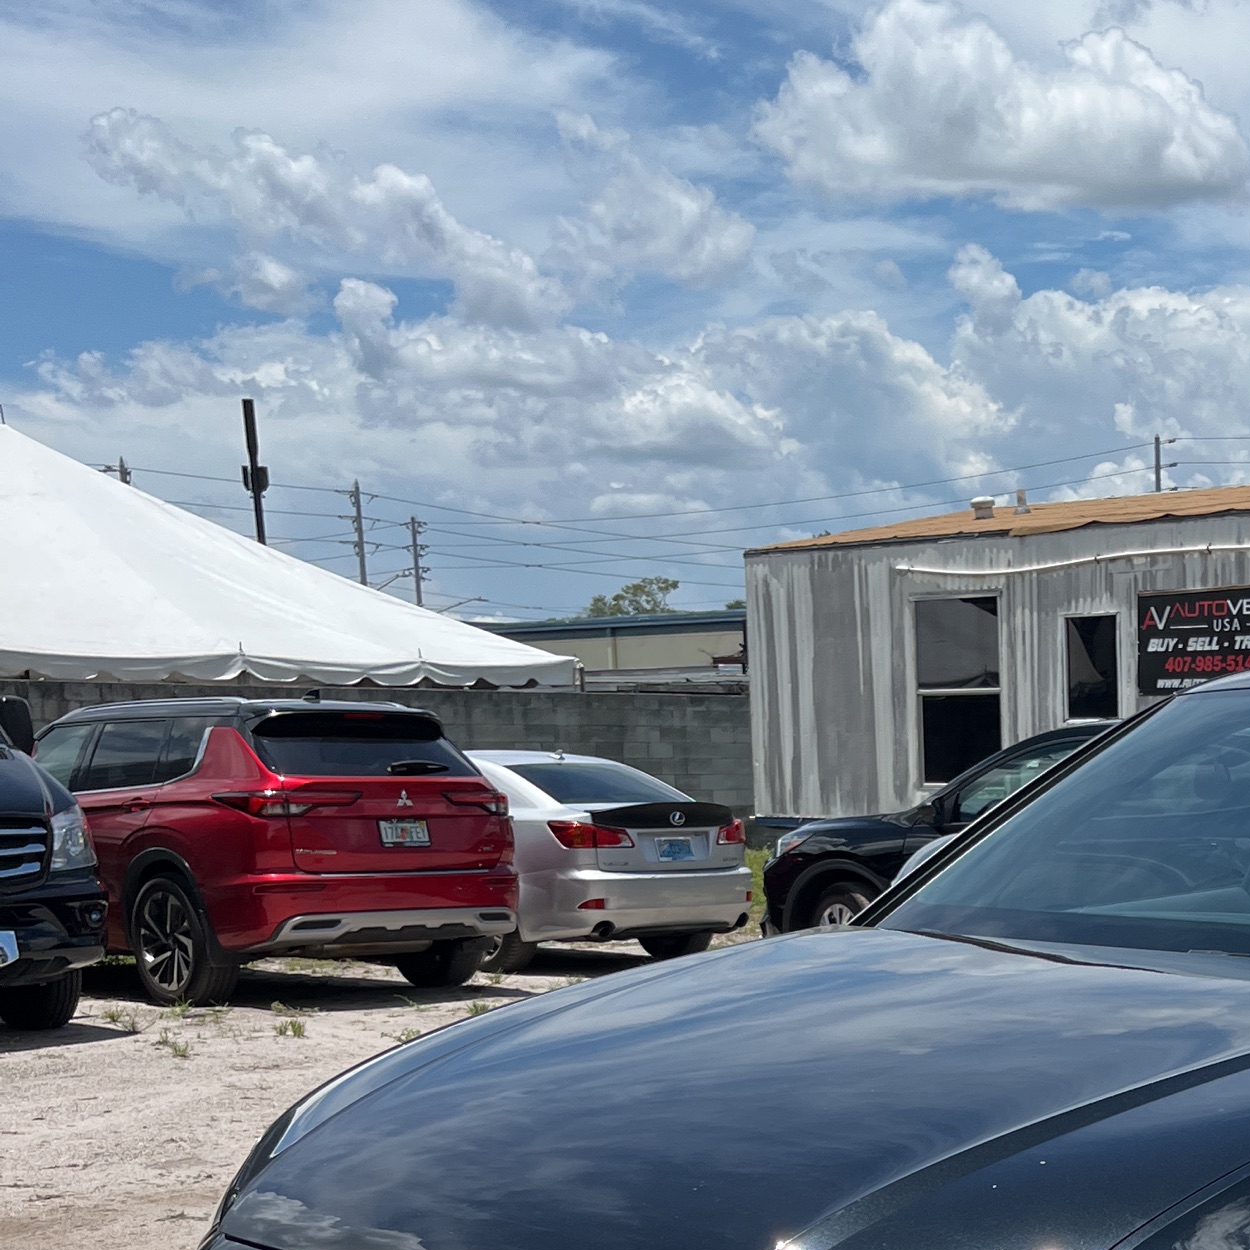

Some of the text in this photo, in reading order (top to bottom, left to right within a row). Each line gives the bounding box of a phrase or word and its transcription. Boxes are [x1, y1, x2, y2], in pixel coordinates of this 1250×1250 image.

[1142, 605, 1171, 631] AV
[1213, 618, 1241, 632] USA
[1147, 637, 1179, 652] BUY
[1186, 636, 1220, 651] SELL
